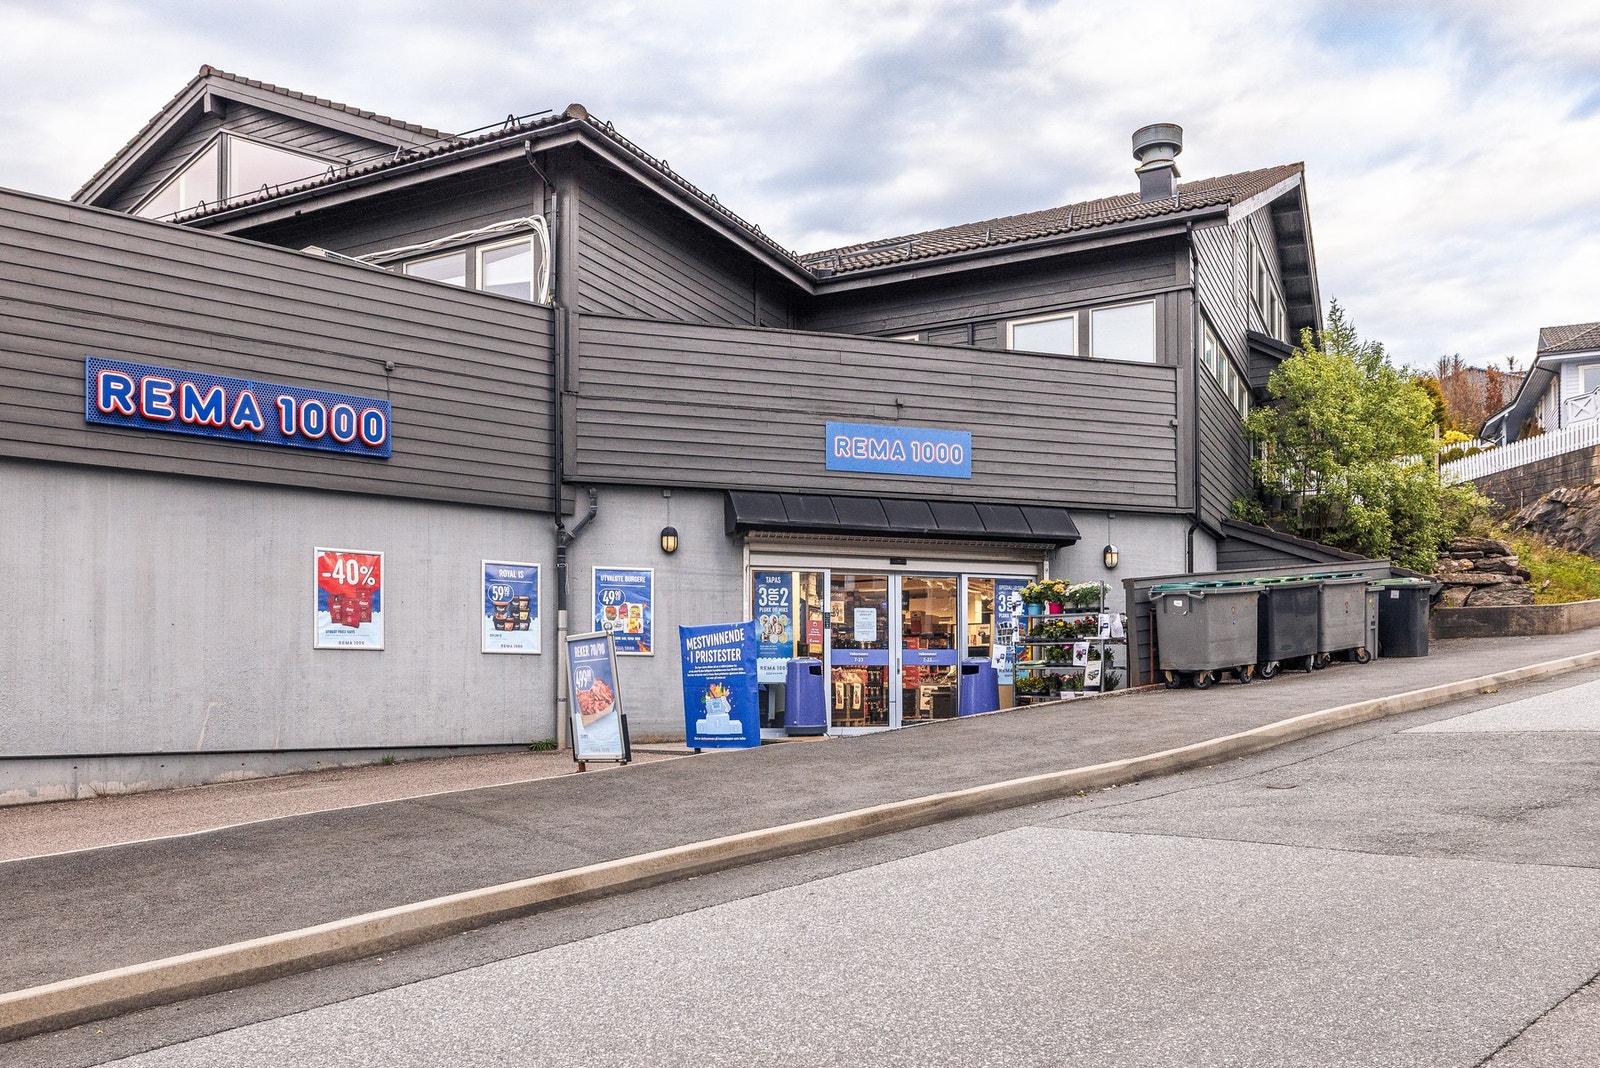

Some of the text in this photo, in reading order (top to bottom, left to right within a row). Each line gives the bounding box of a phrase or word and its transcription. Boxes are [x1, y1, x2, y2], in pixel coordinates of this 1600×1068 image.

[97, 369, 386, 447] REMA 1000
[834, 436, 964, 465] REMA 1000
[321, 558, 376, 586] -40%
[498, 568, 517, 579] ROYAL
[765, 576, 782, 584] TAPAS
[758, 587, 789, 607] 3 FOR 2
[686, 628, 745, 651] MESTVINNENDE
[695, 648, 742, 664] PRISTESTER
